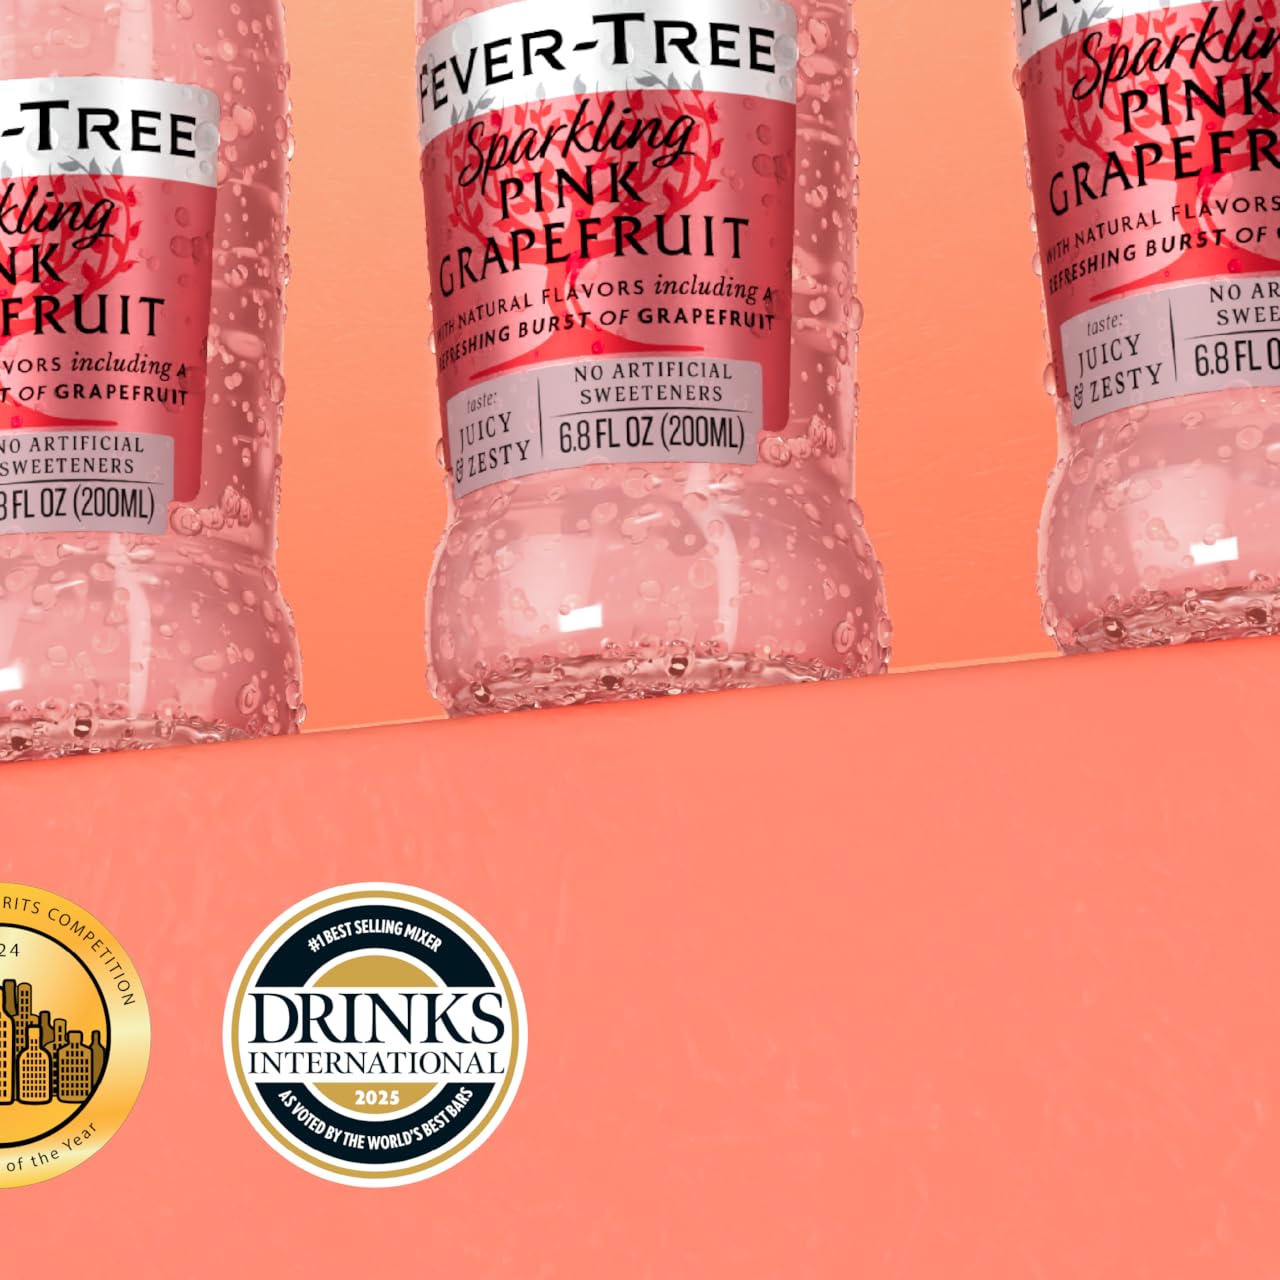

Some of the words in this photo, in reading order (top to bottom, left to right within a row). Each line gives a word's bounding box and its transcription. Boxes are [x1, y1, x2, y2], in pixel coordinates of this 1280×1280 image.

[419, 12, 776, 123] FEVER-TREE
[1121, 72, 1280, 134] PINK
[457, 99, 697, 196] Sparkling
[498, 161, 644, 220] PINK
[1075, 210, 1161, 248] NATURAL
[1146, 229, 1227, 257] BURST
[1236, 226, 1267, 243] OF
[439, 215, 748, 298] GRAPEFRUIT
[458, 297, 533, 326] NATURAL
[542, 281, 644, 304] FLAVORS
[655, 277, 759, 304] including
[1210, 284, 1240, 303] NO
[519, 312, 591, 339] BURST
[600, 311, 629, 326] OF
[638, 308, 775, 331] GRAPEFRUIT
[1087, 313, 1123, 336] taste:
[71, 352, 172, 381] including
[575, 365, 603, 383] NO
[613, 361, 732, 380] ARTIFICIAL
[1078, 334, 1140, 378] JUICY
[1195, 343, 1229, 376] 6.8
[1235, 340, 1261, 372] FL
[19, 386, 47, 401] OF
[55, 384, 188, 405] GRAPEFRUIT
[580, 386, 723, 405] SWEETENERS
[1091, 363, 1163, 403] ZESTY
[467, 391, 498, 415] taste:
[29, 436, 144, 452] ARTIFICIAL
[459, 412, 512, 453] JUICY
[559, 420, 590, 454] 6.8
[596, 418, 620, 449] FL
[627, 416, 653, 447] OZ
[660, 412, 745, 455] (200ML)
[0, 459, 134, 477] SWEETENERS
[468, 440, 531, 479] ZESTY
[13, 489, 34, 519] FL
[40, 488, 66, 518] OZ
[73, 484, 155, 525] (200ML)
